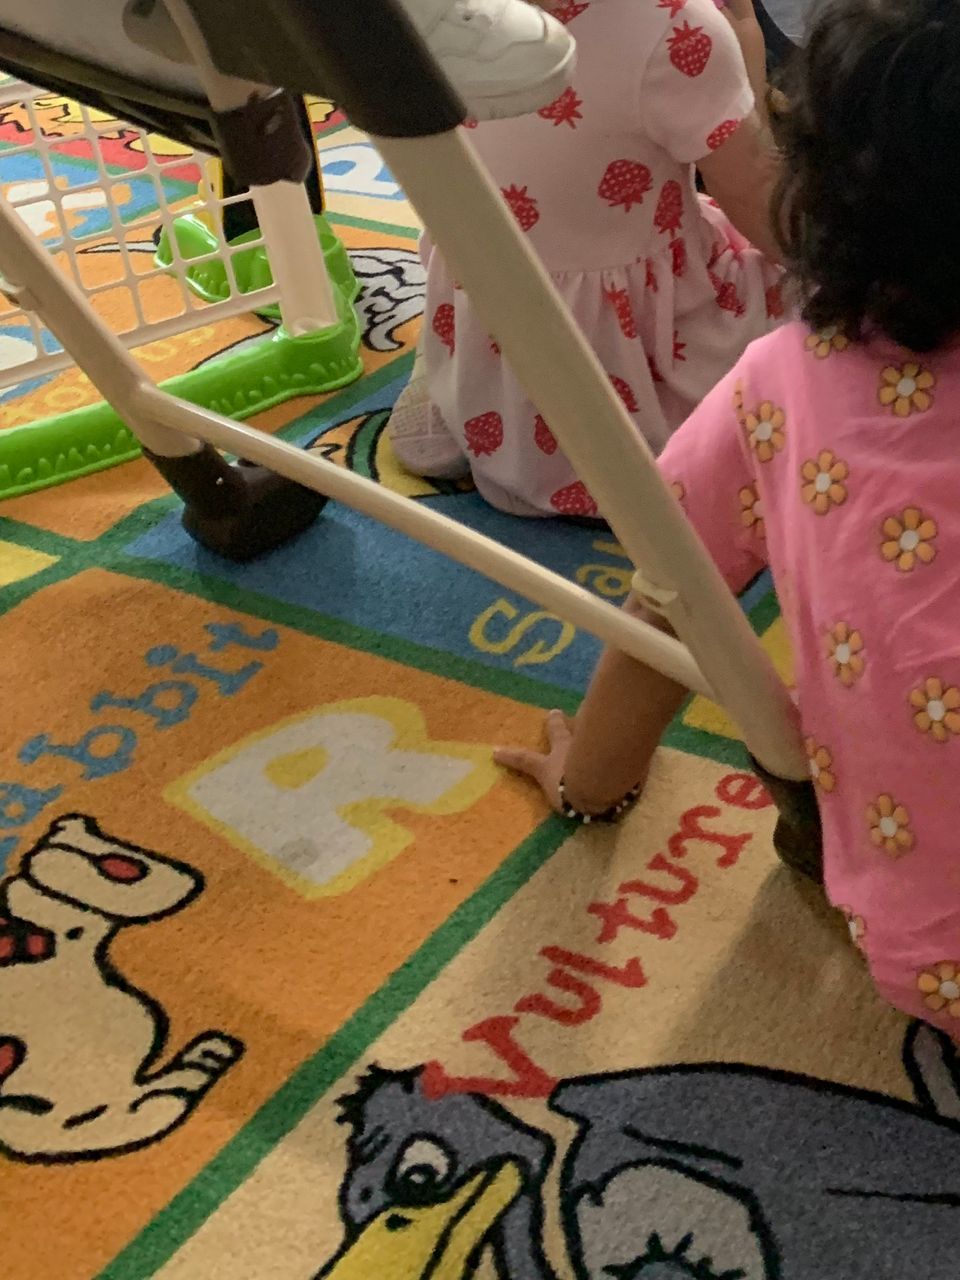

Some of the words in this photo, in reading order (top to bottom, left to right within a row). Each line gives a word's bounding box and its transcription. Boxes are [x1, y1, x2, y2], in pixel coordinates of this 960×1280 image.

[0, 622, 281, 876] abbit
[162, 694, 500, 901] R
[420, 772, 776, 1102] Vulture
